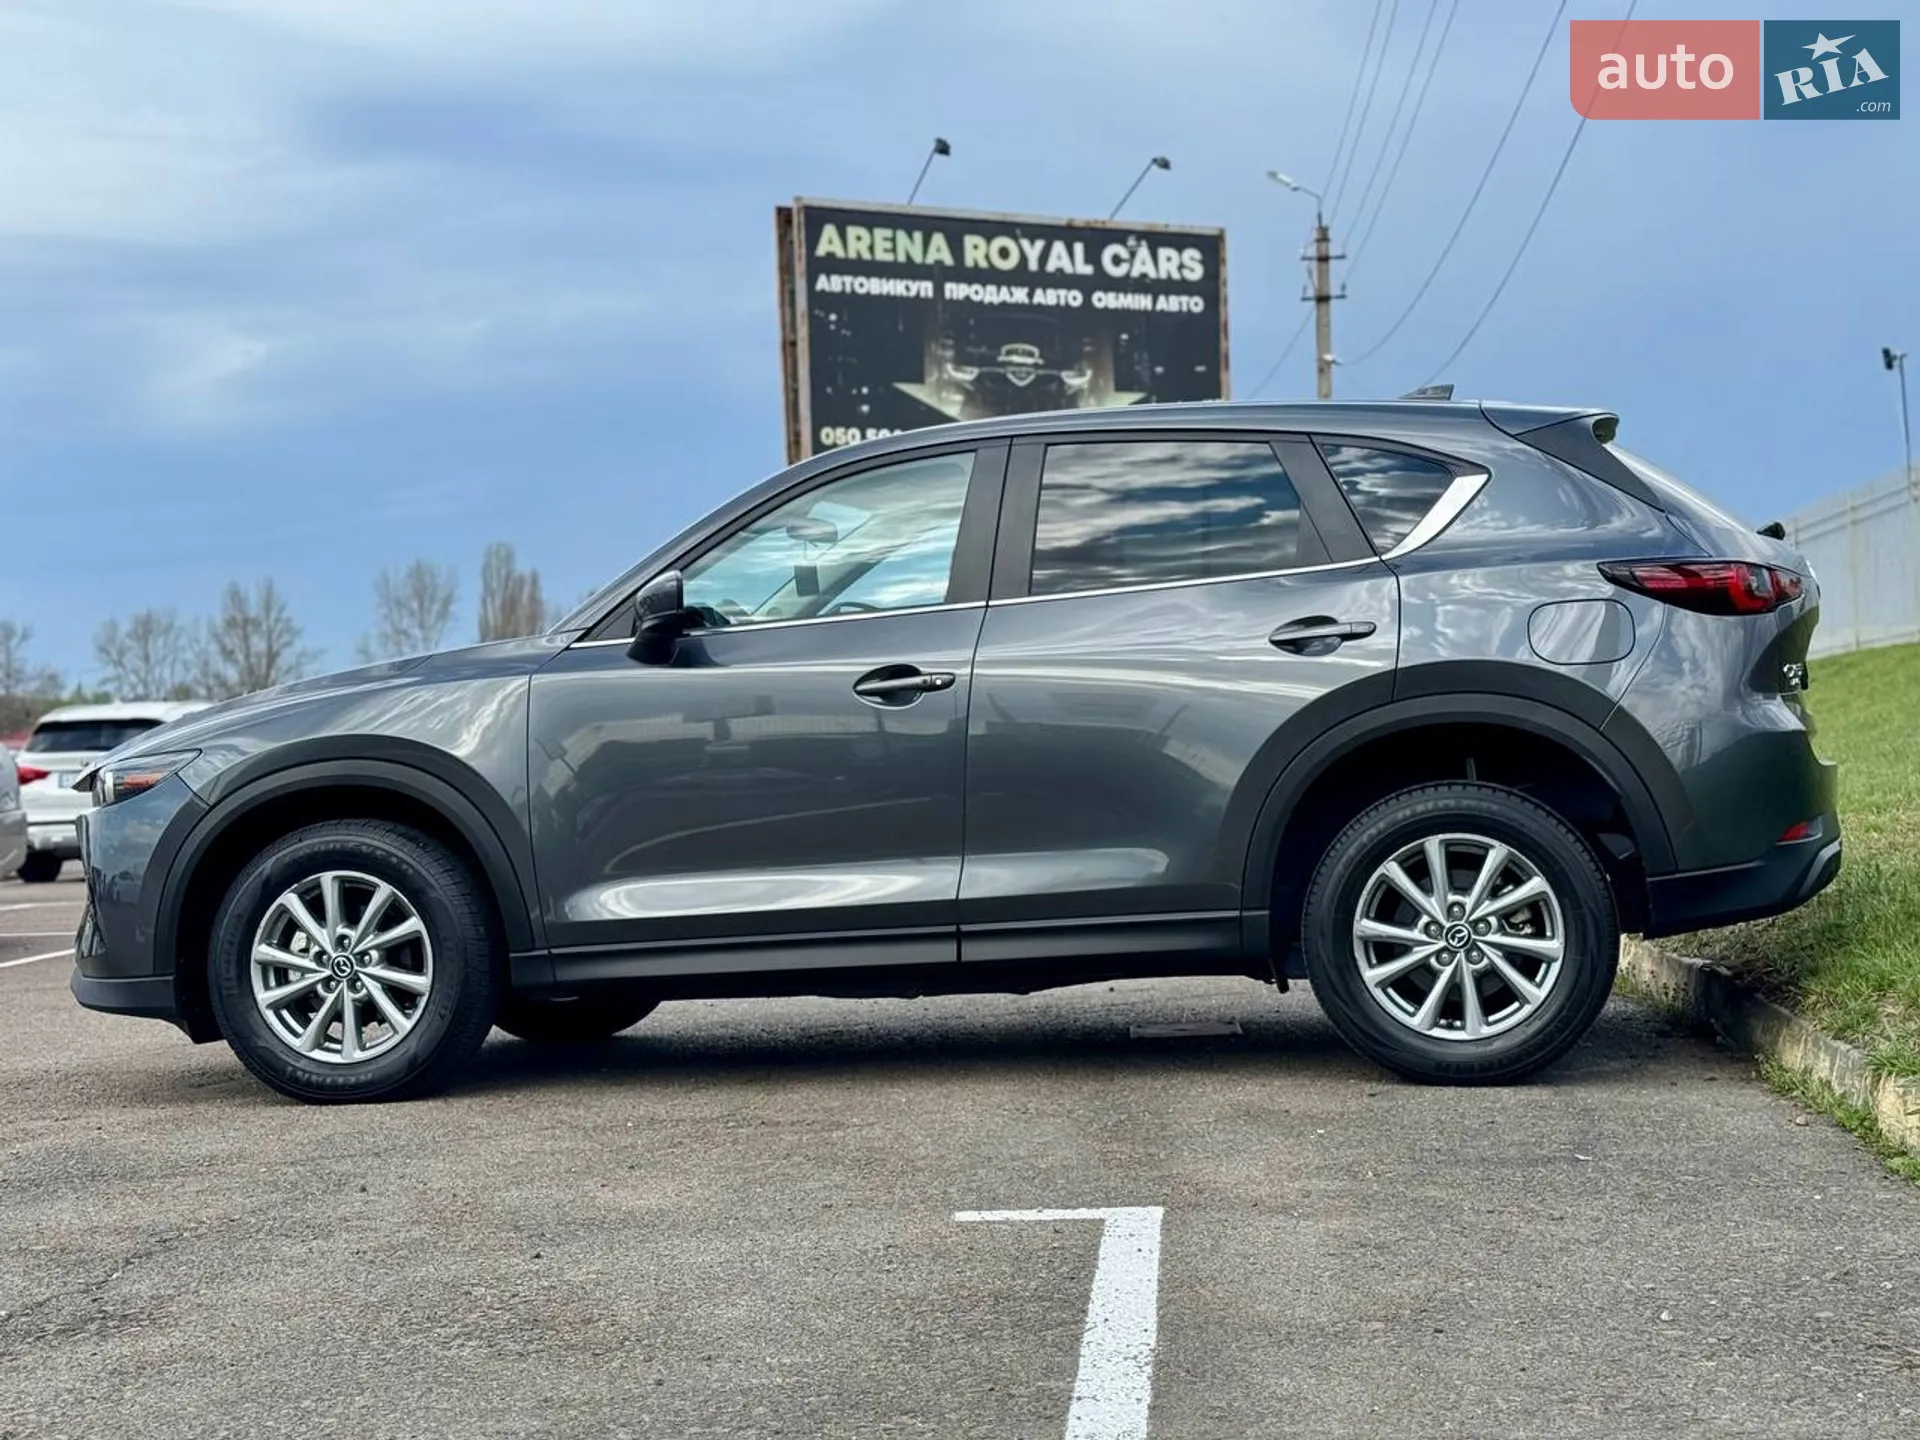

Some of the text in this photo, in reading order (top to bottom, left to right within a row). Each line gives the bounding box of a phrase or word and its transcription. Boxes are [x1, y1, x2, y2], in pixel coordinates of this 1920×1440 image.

[815, 223, 1205, 281] ARENA ROYAL CARS
[815, 273, 1206, 314] АВТОВИКУП ПРОДАЖ АВТО ОБМІН АВТО
[820, 426, 861, 446] 050
